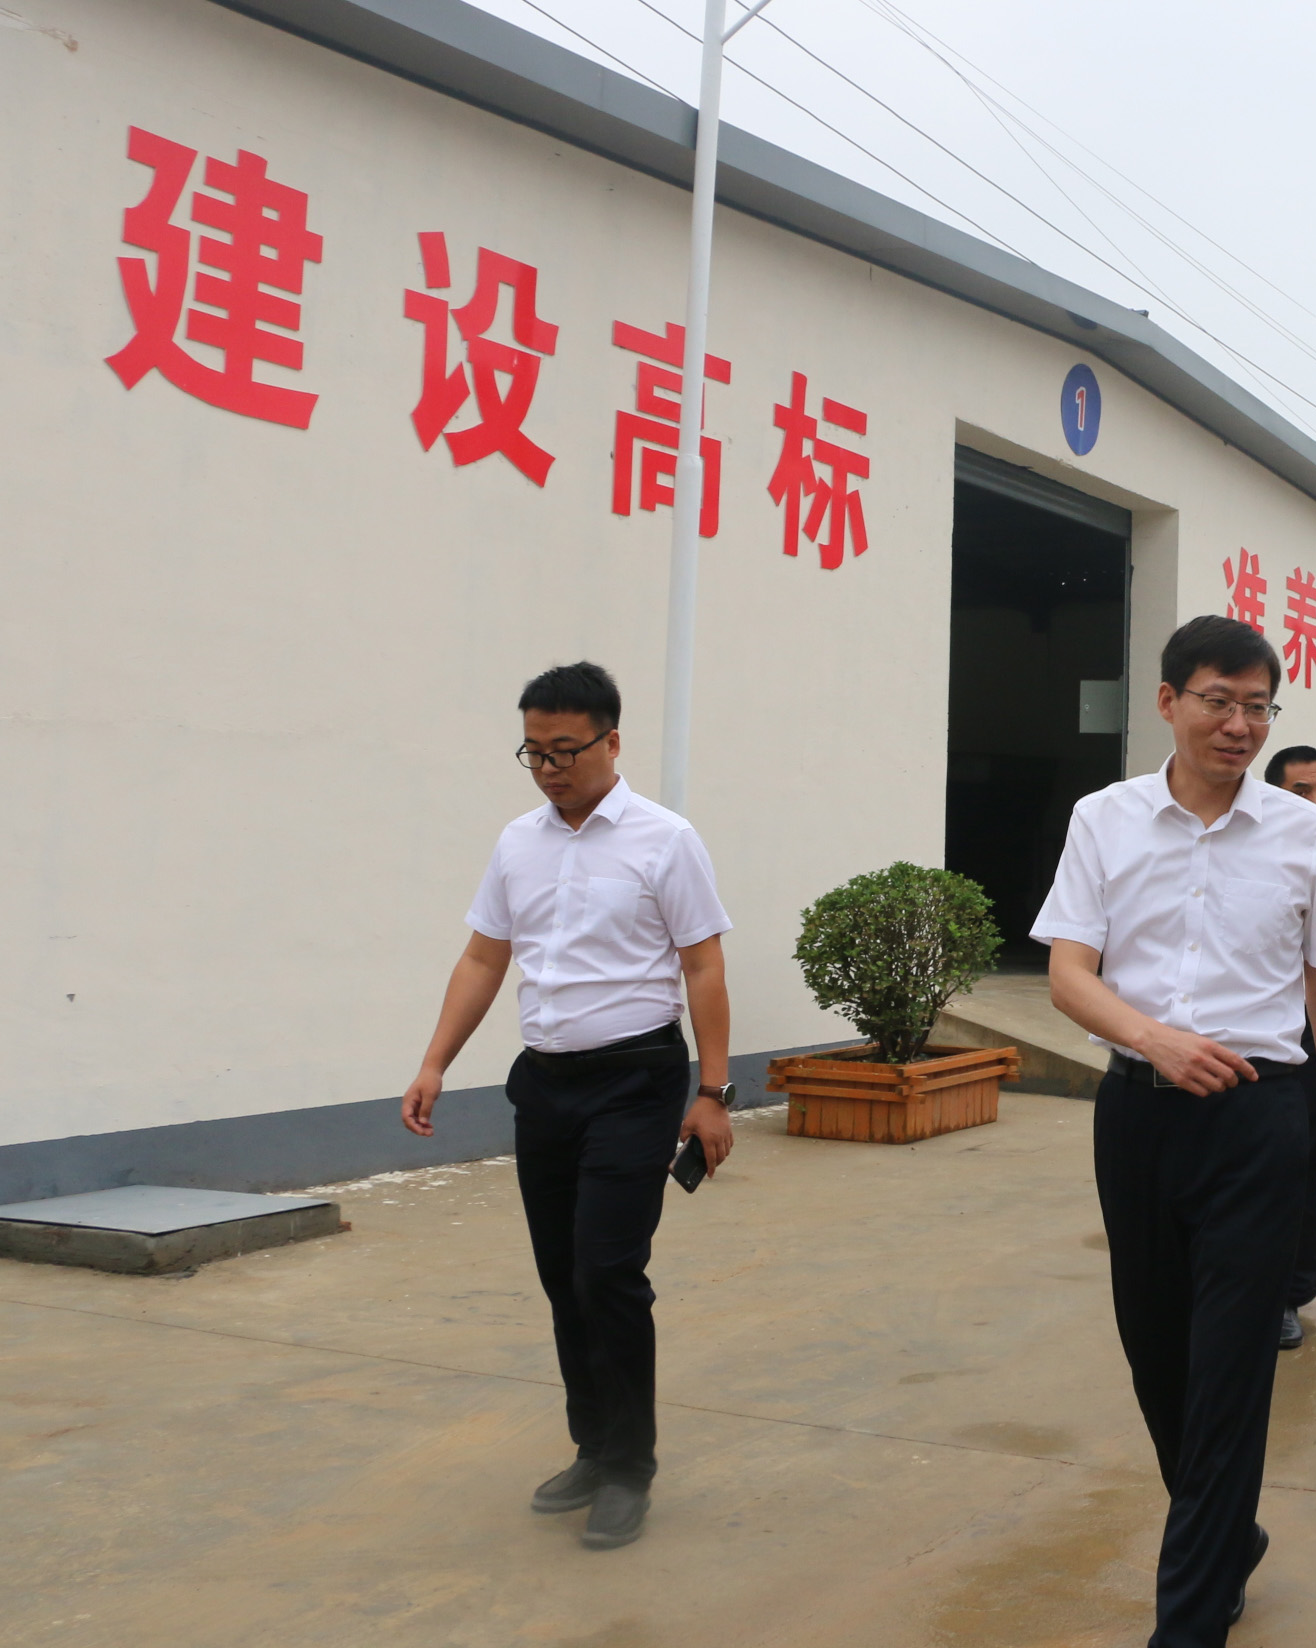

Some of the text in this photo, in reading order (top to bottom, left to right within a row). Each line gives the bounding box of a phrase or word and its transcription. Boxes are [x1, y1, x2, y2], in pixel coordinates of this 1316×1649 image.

[106, 126, 871, 570] 建设高标
[1075, 386, 1086, 431] 1
